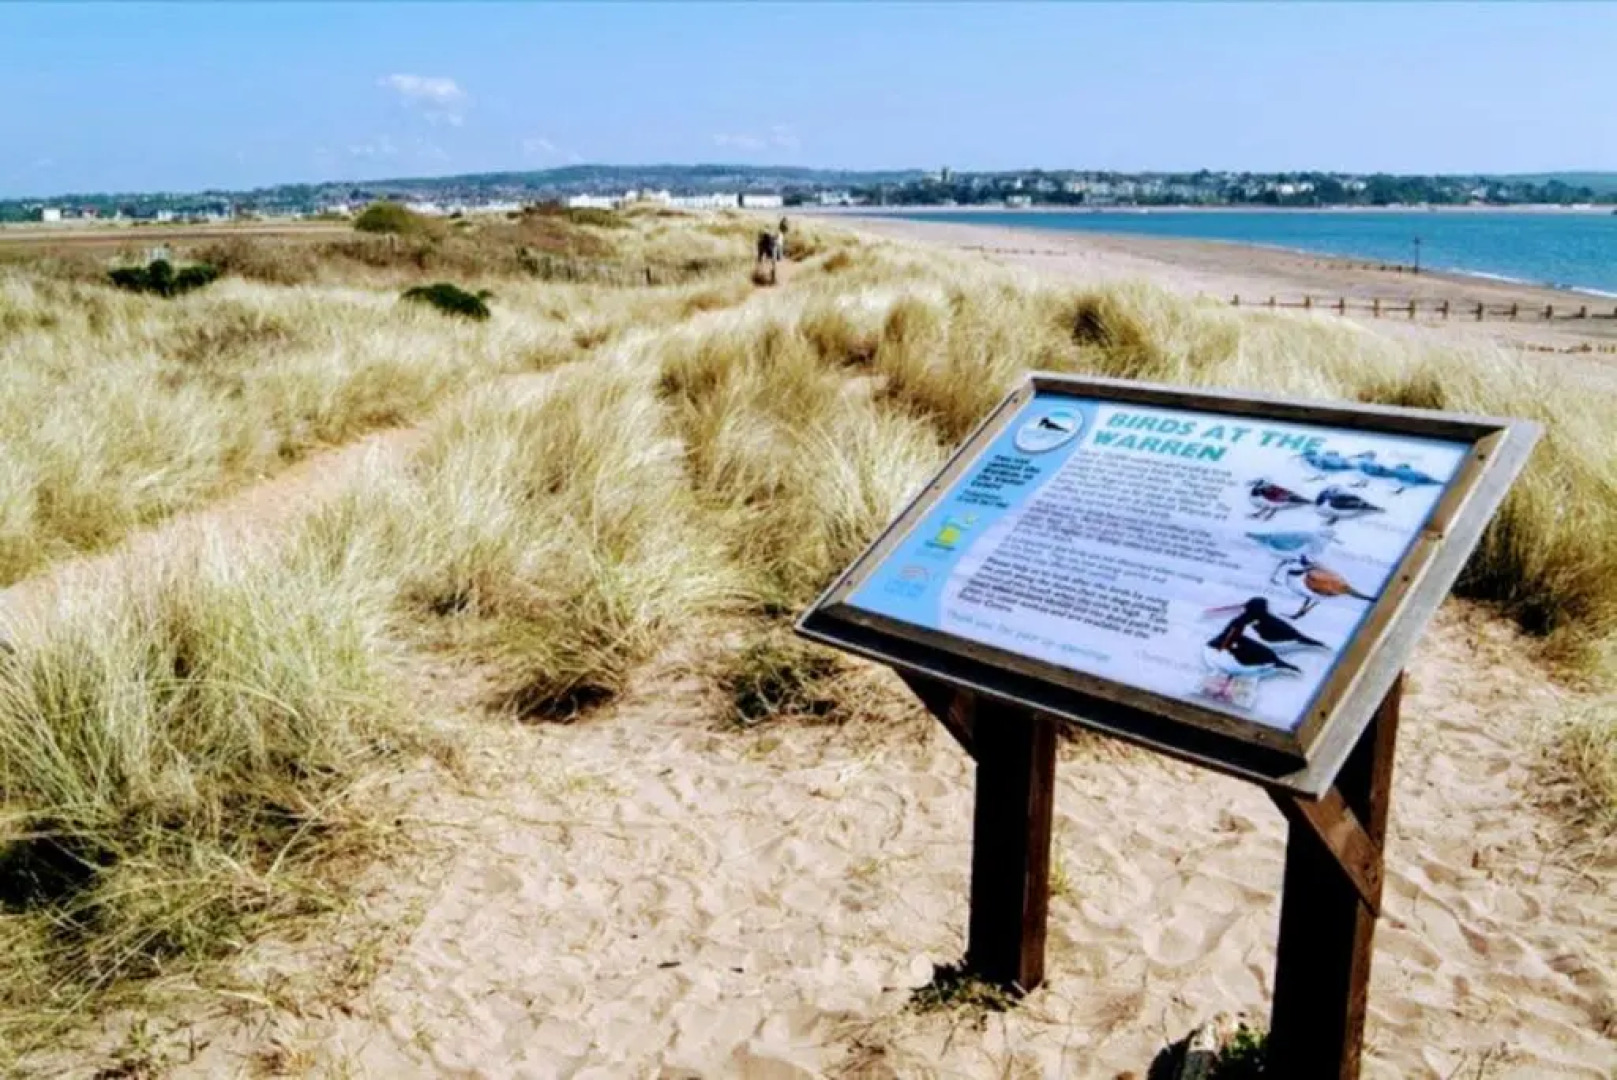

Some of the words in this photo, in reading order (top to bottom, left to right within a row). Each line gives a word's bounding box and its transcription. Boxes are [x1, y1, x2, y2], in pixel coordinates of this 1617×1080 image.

[1093, 430, 1226, 461] WARREN
[1108, 413, 1196, 435] BIRDS
[1201, 424, 1252, 443] AT
[1260, 430, 1325, 450] THE
